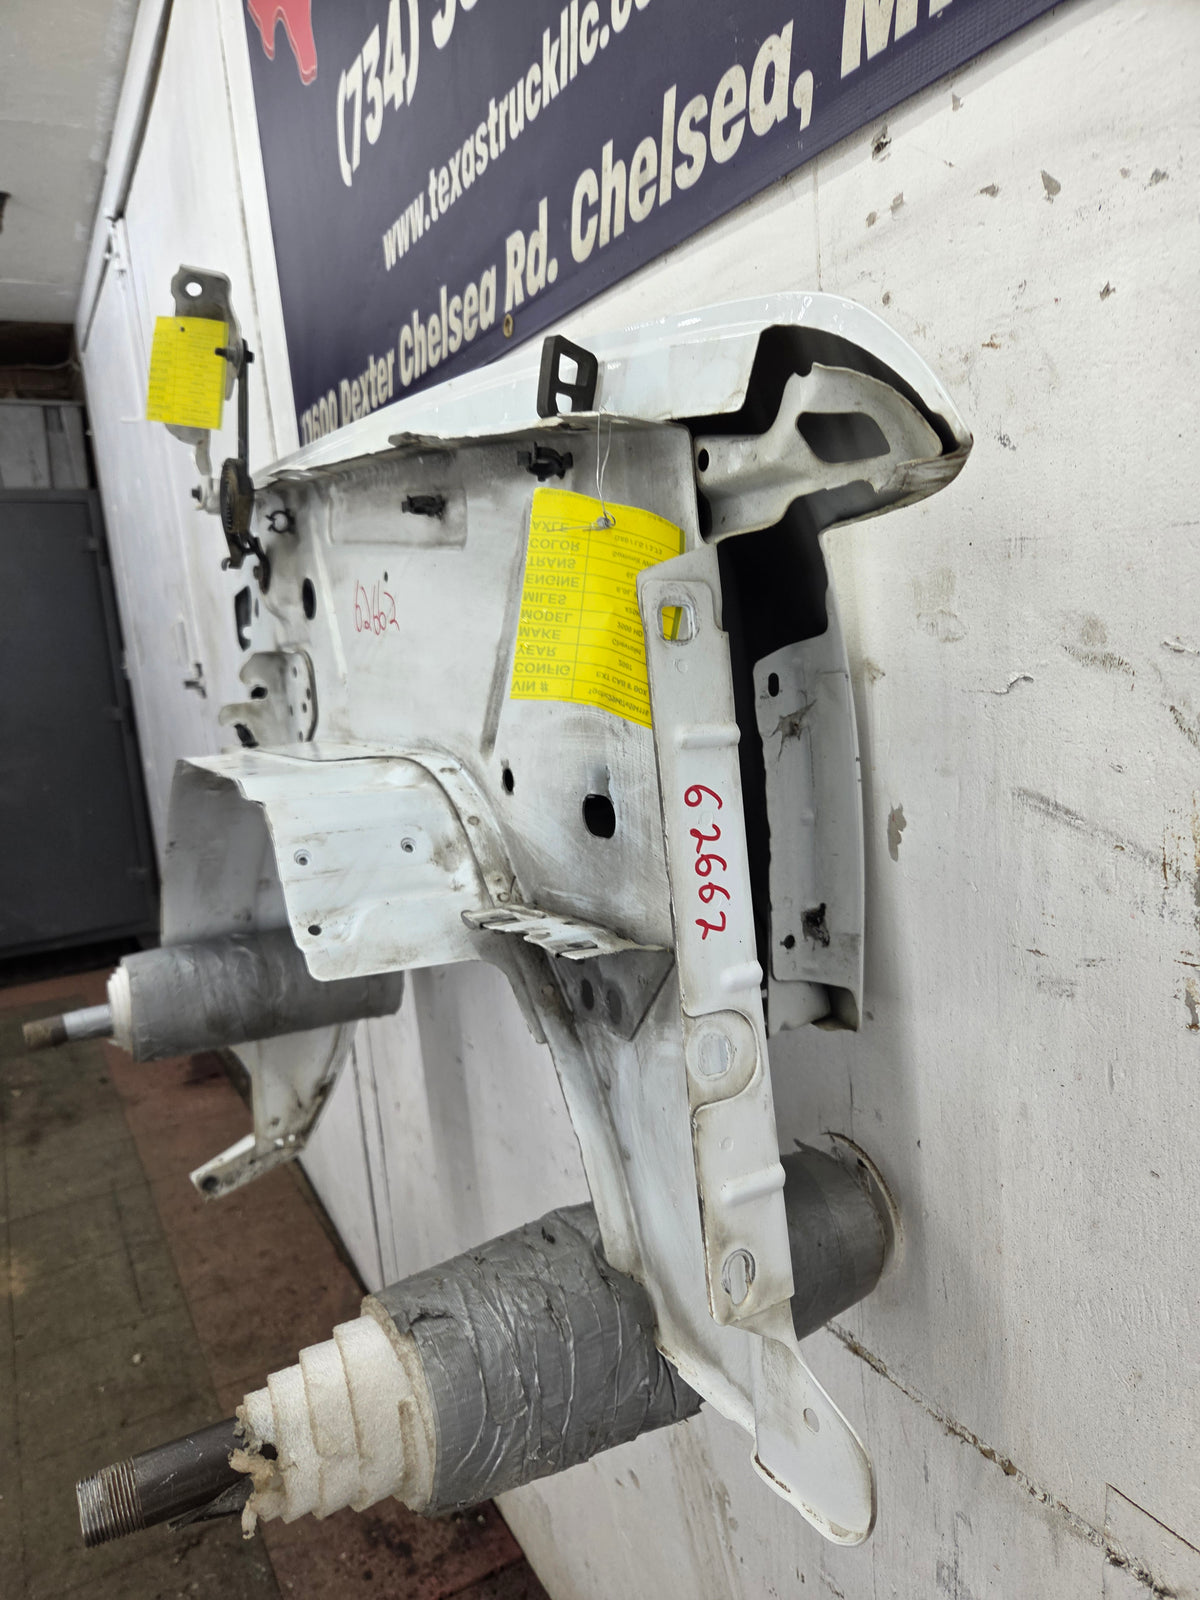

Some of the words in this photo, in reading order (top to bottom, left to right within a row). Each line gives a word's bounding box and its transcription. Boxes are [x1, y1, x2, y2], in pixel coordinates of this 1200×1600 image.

[336, 0, 420, 187] (734)
[340, 348, 396, 426] Dexter
[399, 264, 497, 388] Chelsea
[504, 197, 559, 313] Rd.
[570, 19, 814, 264] Chelsea,
[354, 579, 401, 636] 62662
[683, 783, 732, 941] 62662
